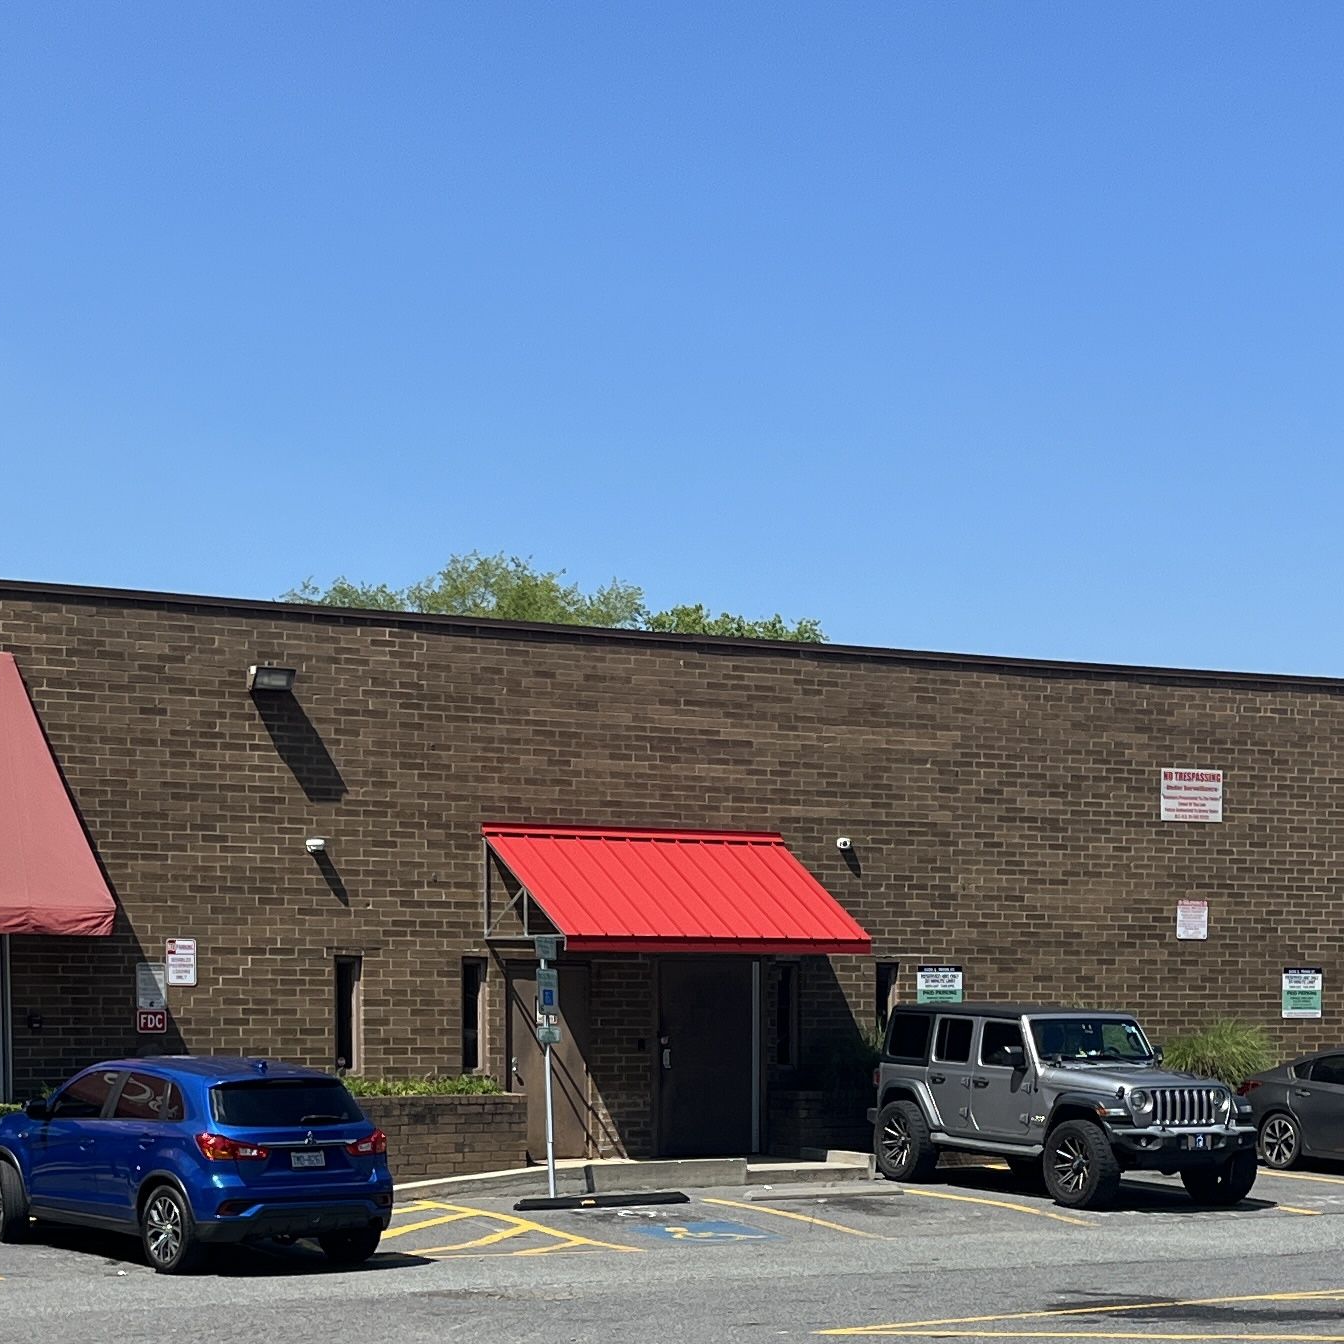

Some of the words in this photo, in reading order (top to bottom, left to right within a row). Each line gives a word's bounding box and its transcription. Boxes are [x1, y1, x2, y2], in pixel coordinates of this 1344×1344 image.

[1163, 771, 1173, 781] NO
[1175, 772, 1221, 782] TRESPASSING
[140, 1014, 164, 1028] FDC
